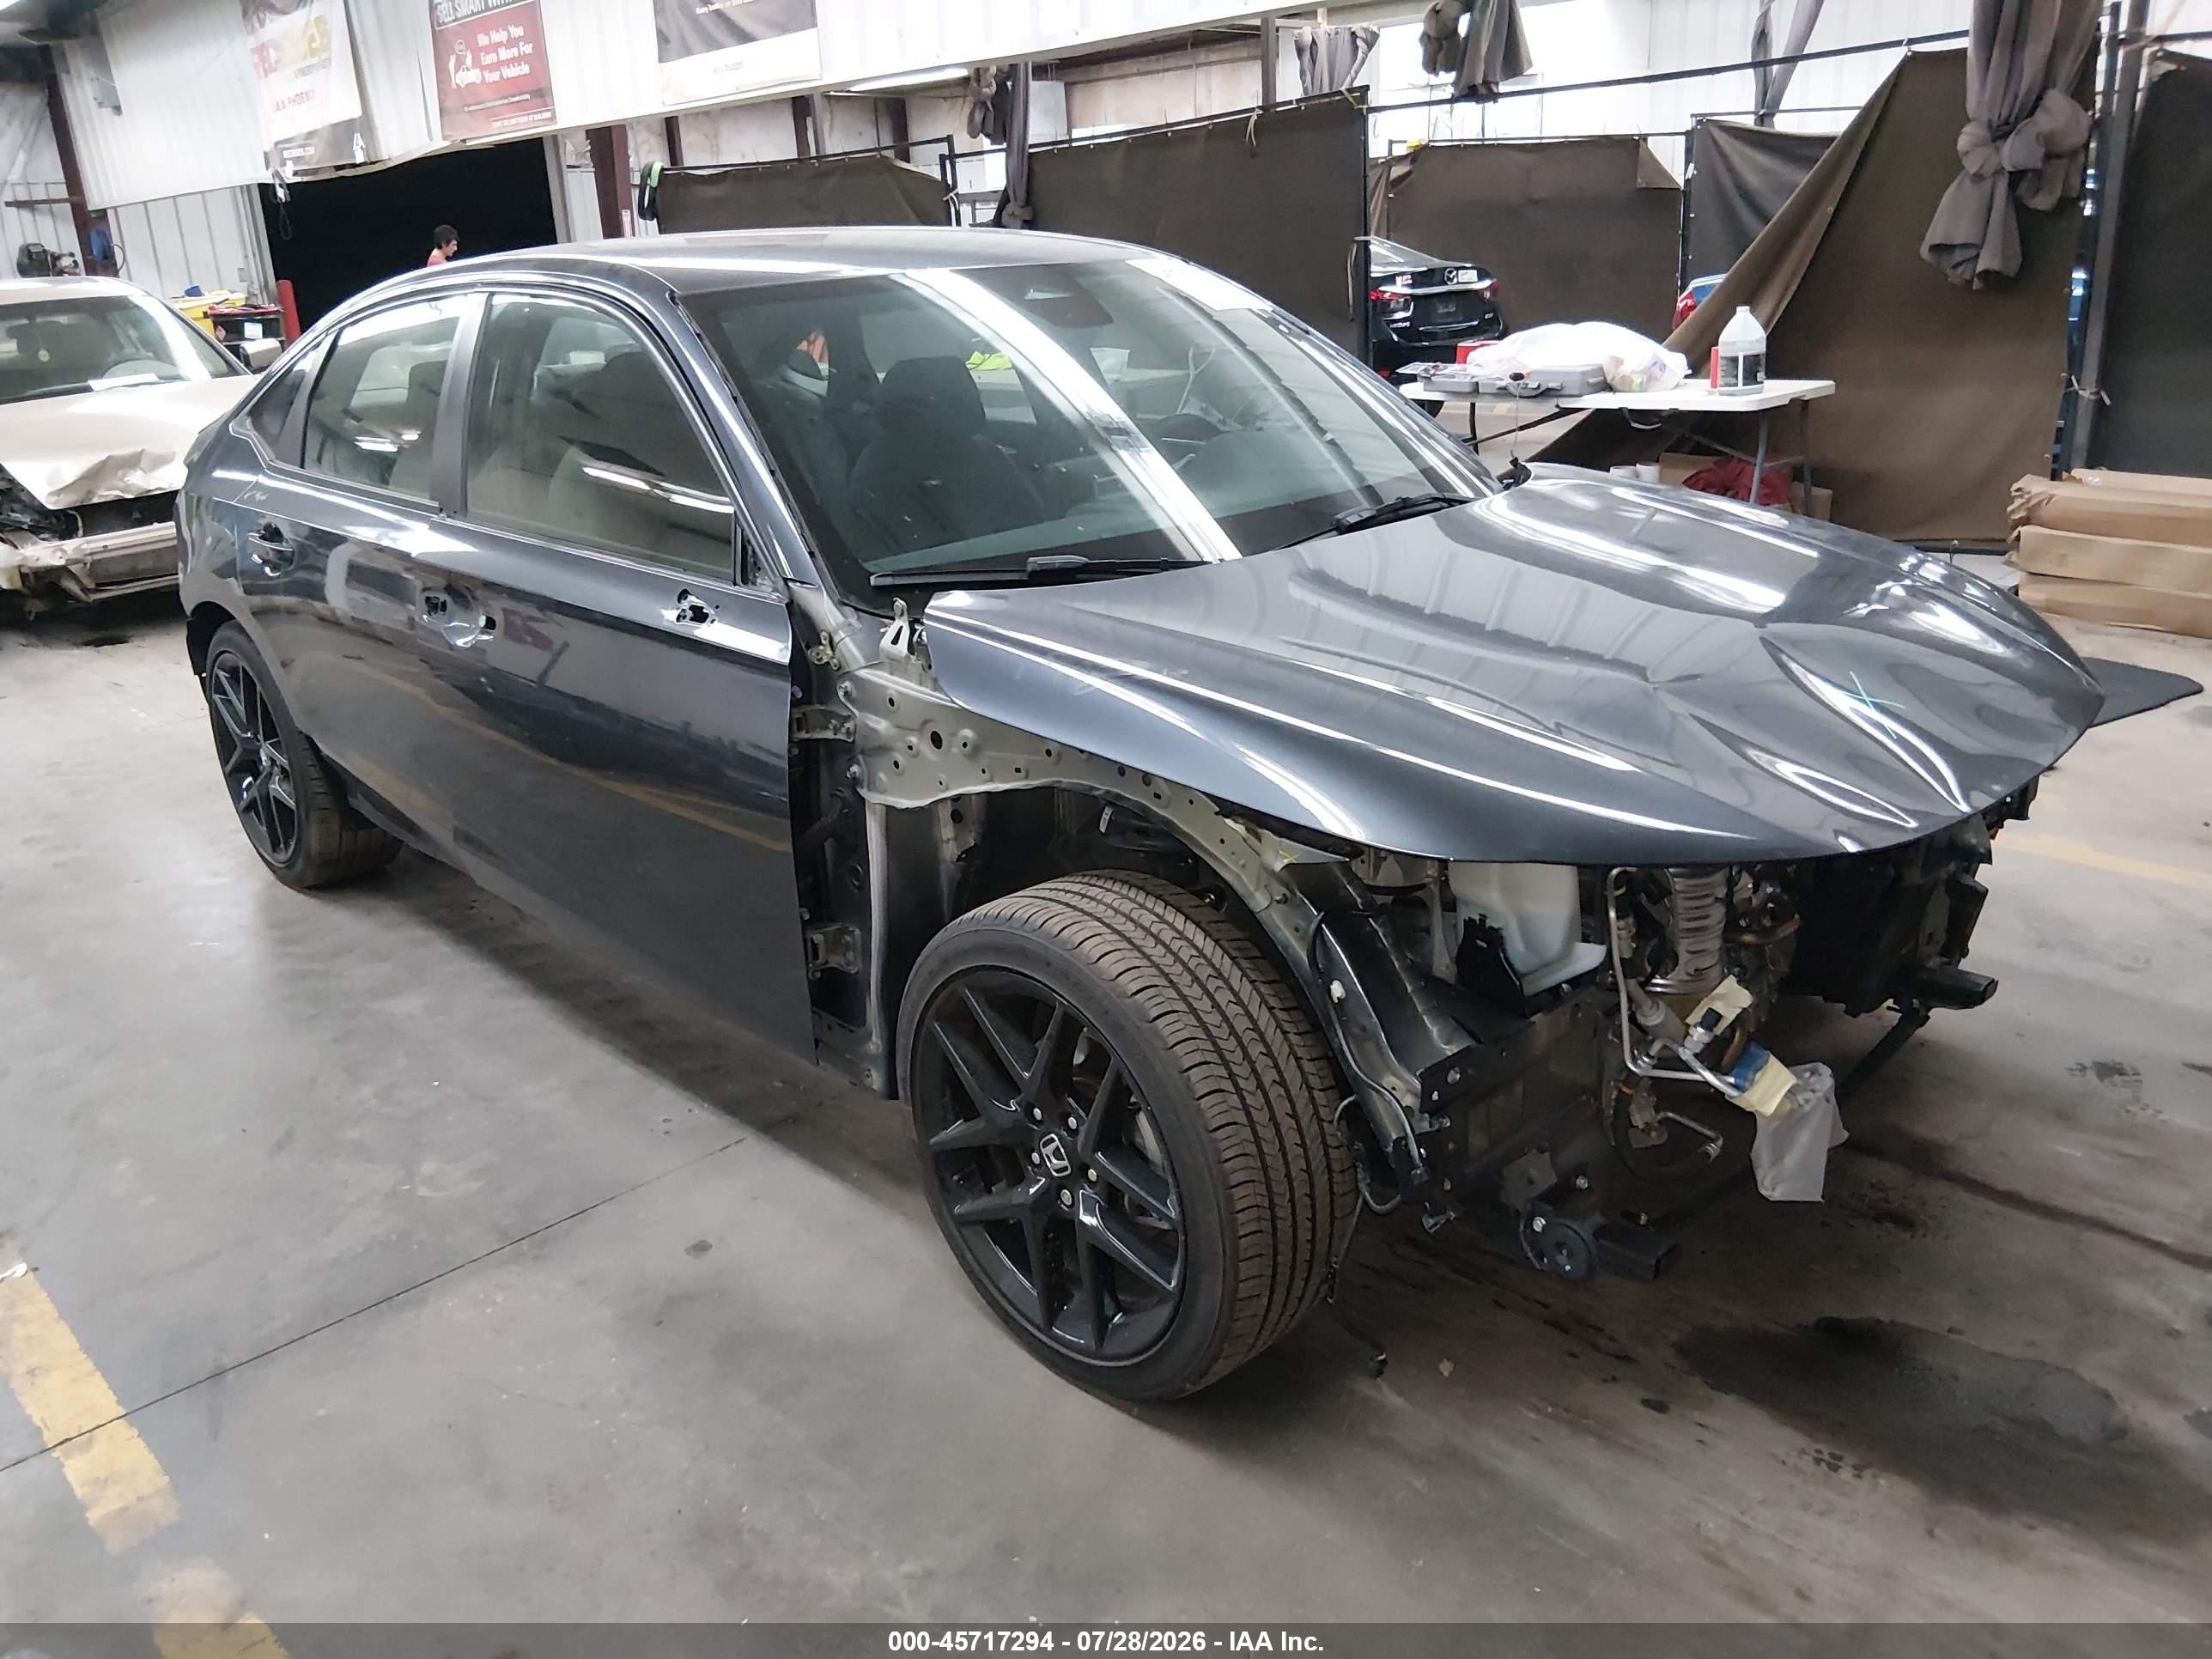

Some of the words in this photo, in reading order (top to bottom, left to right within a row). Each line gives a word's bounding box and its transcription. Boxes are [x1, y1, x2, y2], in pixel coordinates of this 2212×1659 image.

[477, 33, 490, 47] We
[489, 27, 508, 44] Help
[507, 24, 525, 40] You
[480, 52, 498, 65] Earn
[497, 46, 520, 62] More
[519, 41, 534, 56] For
[483, 70, 501, 83] Your
[501, 62, 531, 80] Vehicle
